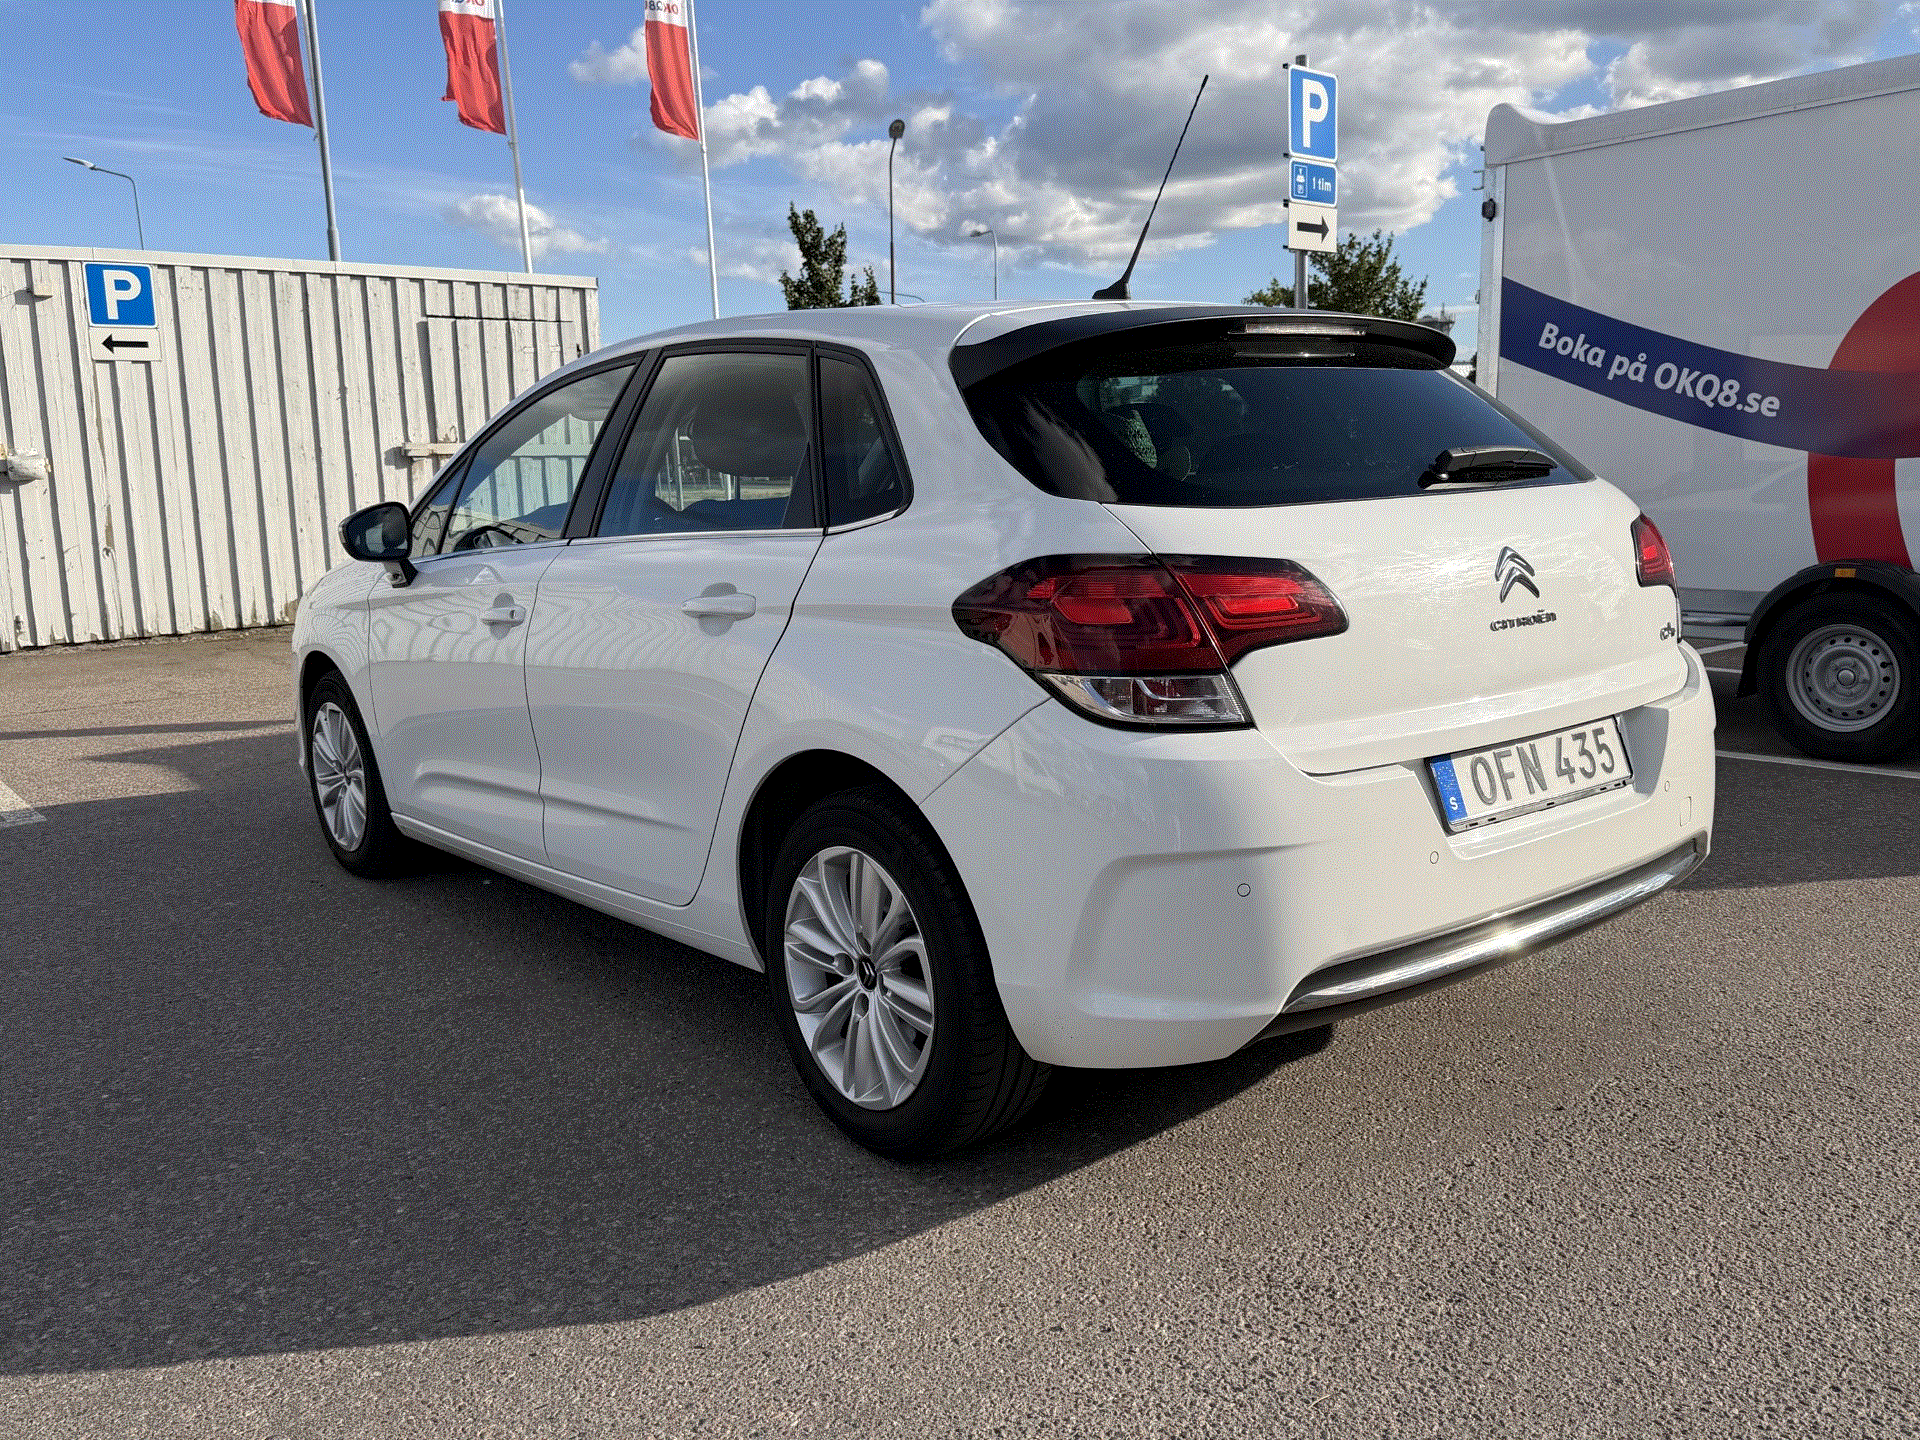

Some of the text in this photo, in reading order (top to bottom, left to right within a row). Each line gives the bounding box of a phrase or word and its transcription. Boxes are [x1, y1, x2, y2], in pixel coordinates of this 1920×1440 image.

[1302, 78, 1329, 148] P
[1312, 176, 1332, 192] 1 tim
[103, 269, 142, 320] P
[1538, 322, 1781, 417] Boka på OKQ8.se
[1449, 727, 1615, 811] S OFN 435
